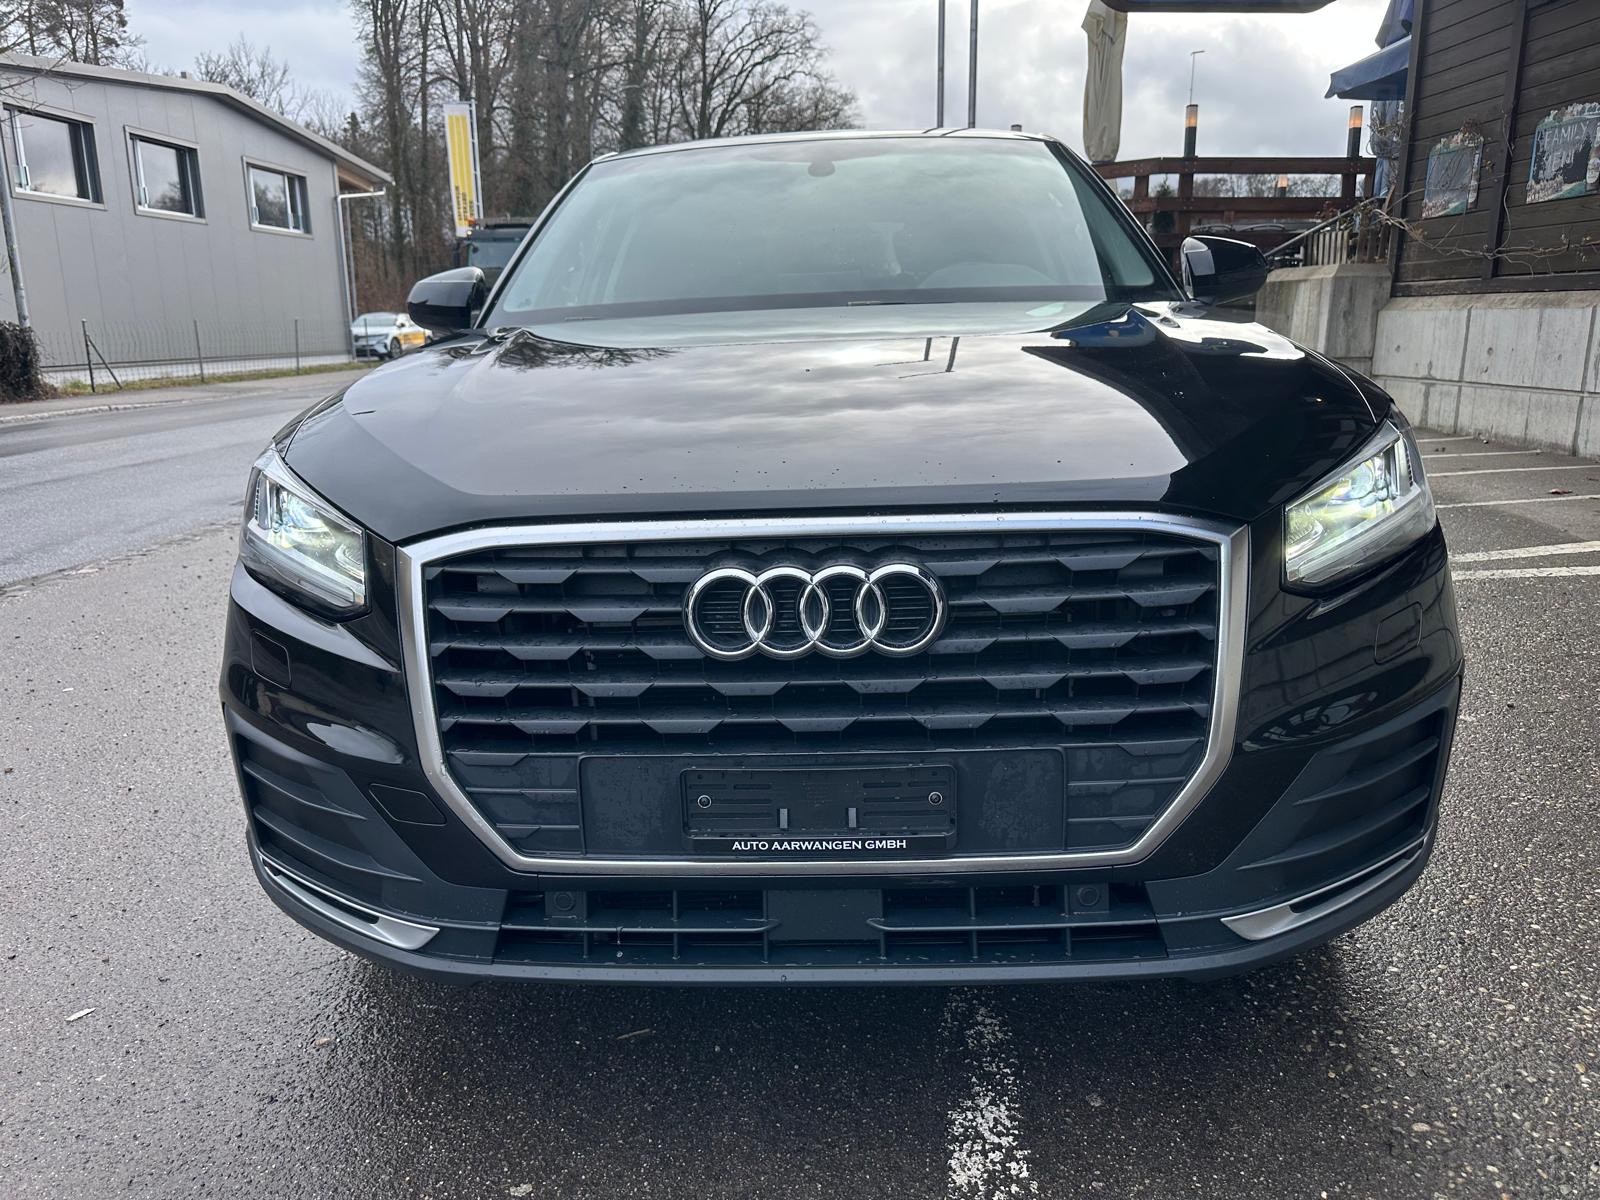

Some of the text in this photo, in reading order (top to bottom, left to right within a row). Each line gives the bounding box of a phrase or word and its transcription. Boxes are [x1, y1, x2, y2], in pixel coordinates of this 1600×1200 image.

[1544, 121, 1589, 146] FAMILY
[732, 839, 907, 851] AUTO AARWANGEN GMBH
